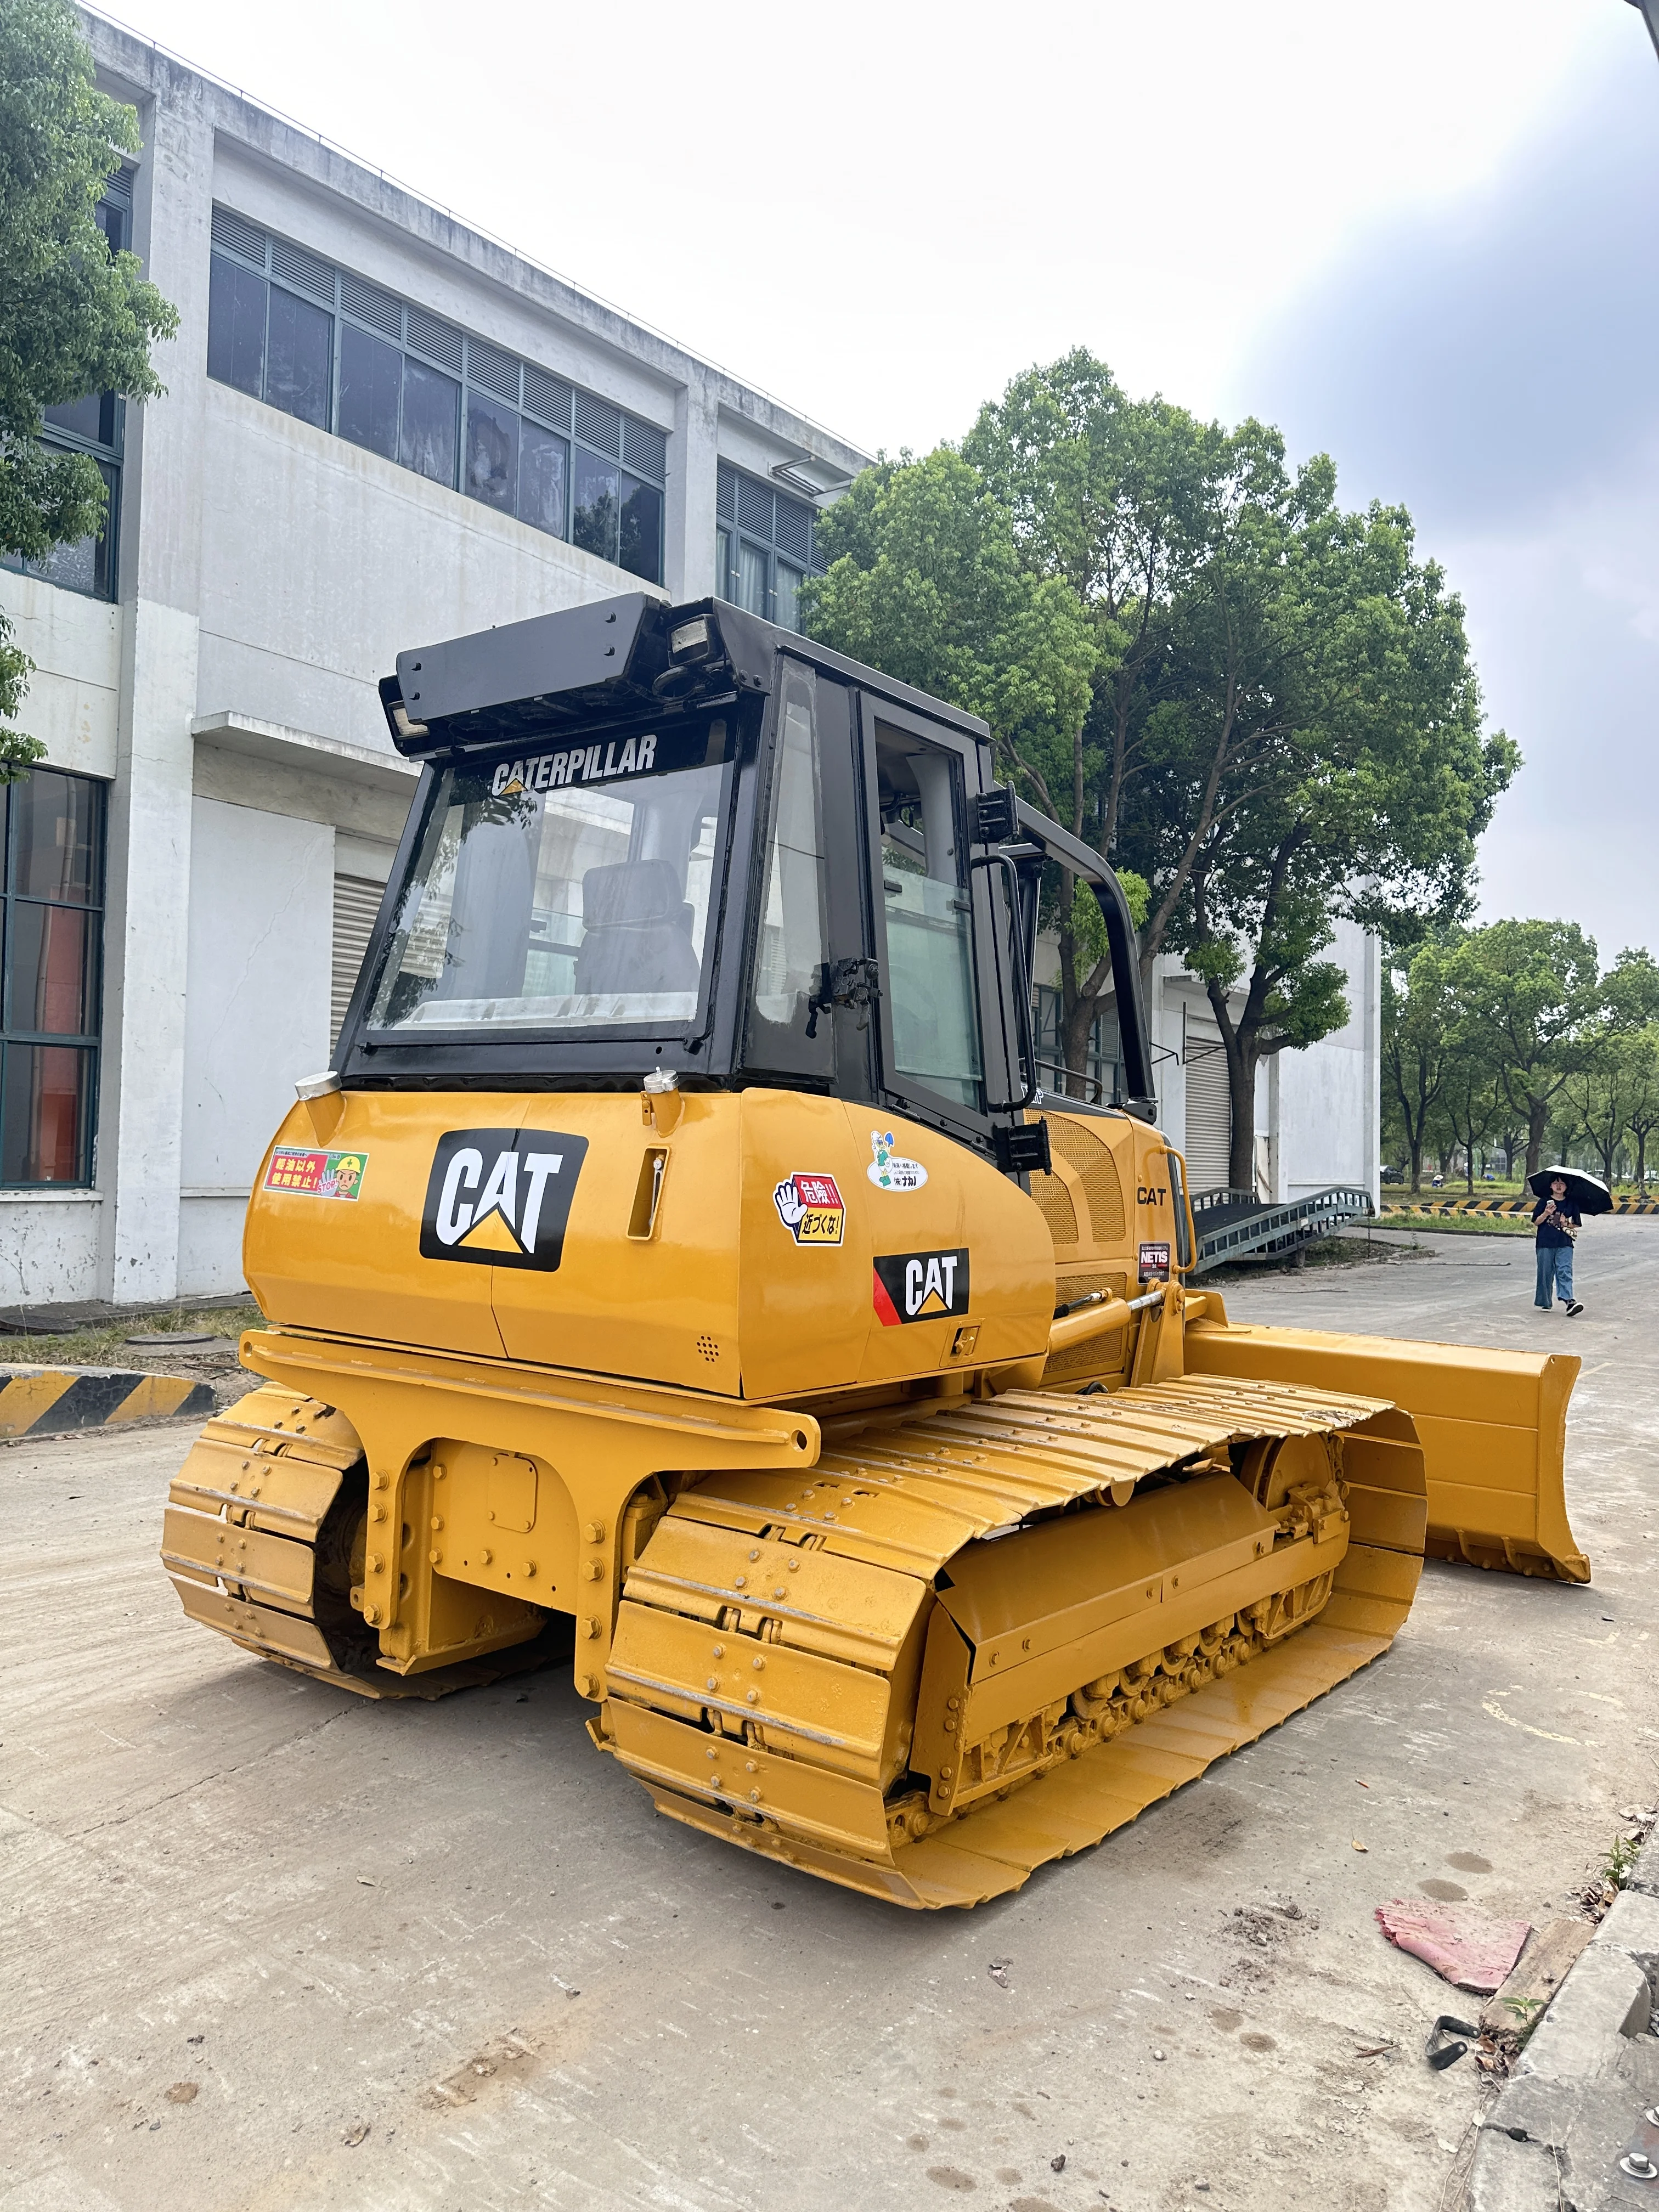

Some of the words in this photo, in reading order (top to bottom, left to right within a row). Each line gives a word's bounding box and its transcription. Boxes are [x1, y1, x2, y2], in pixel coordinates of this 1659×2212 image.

[492, 734, 657, 795] CATERPILLAR
[436, 1148, 563, 1254] CAT
[1137, 1187, 1166, 1206] CAT
[906, 1256, 957, 1316] CAT
[1141, 1251, 1168, 1263] NETIS
